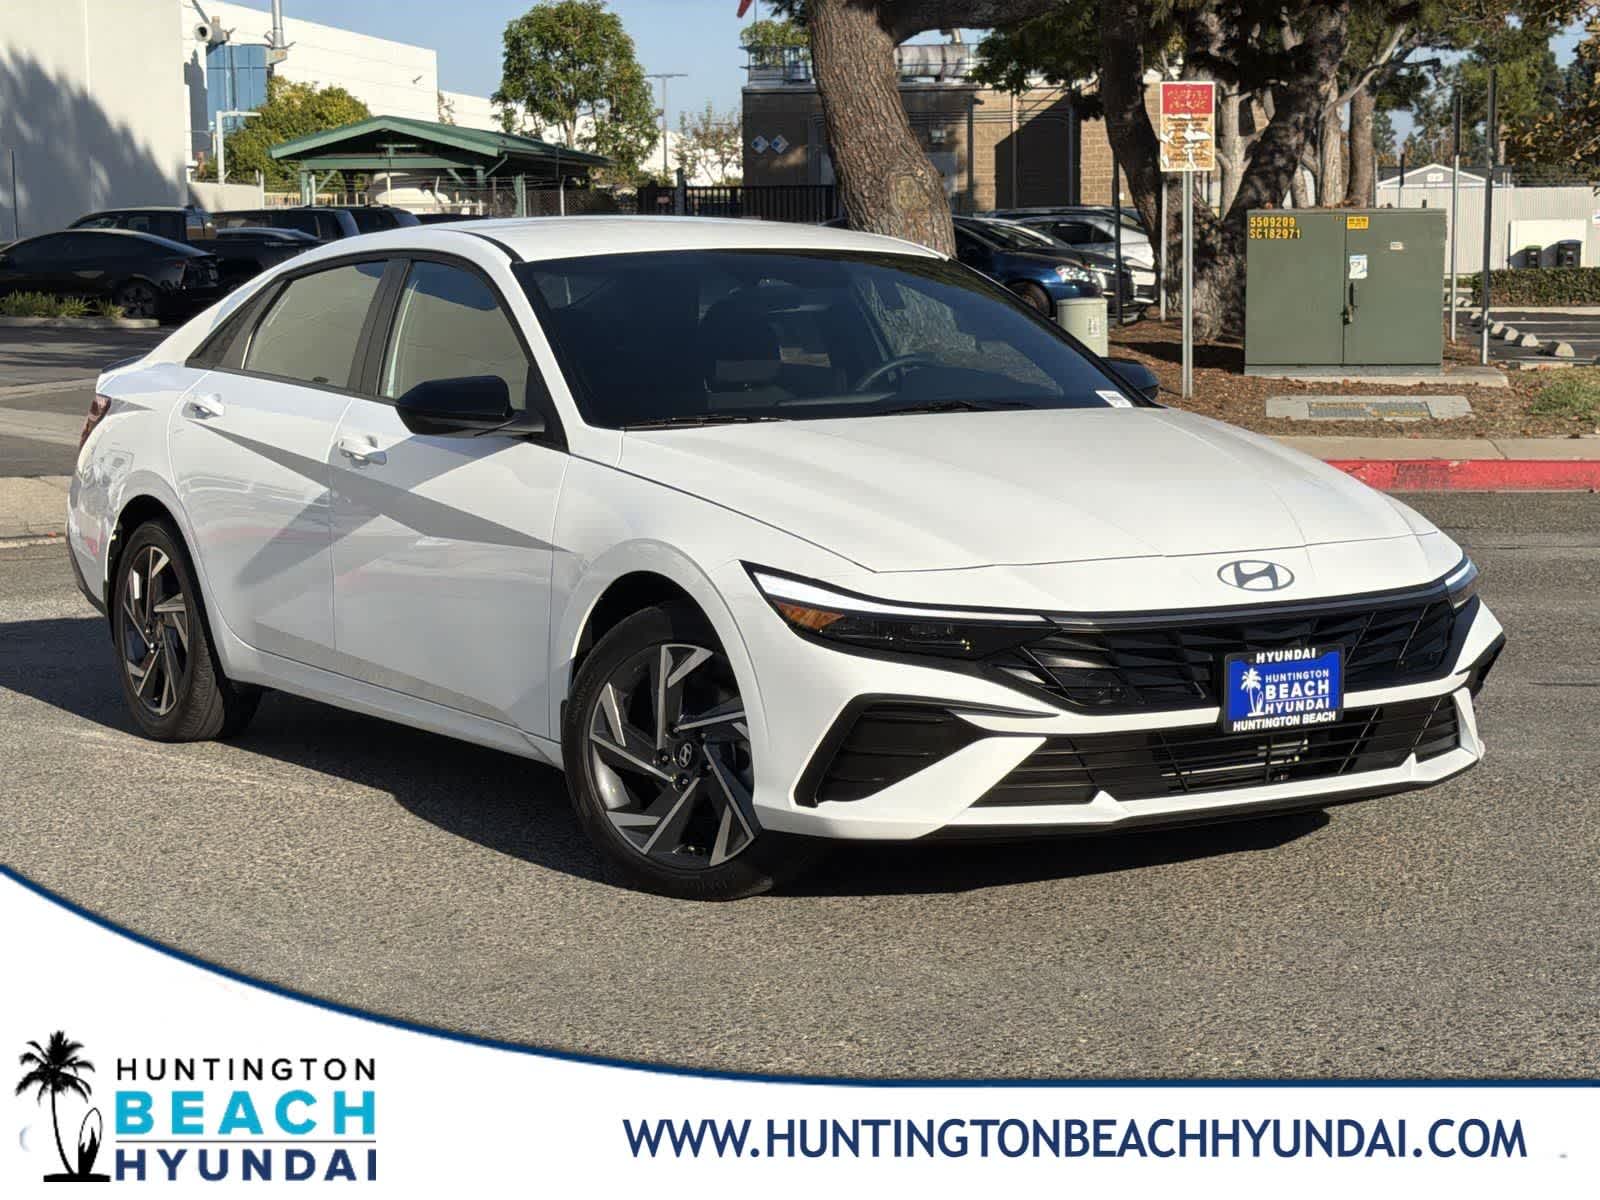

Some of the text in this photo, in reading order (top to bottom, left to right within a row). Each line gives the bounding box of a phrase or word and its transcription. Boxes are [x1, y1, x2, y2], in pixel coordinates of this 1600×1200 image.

[1250, 216, 1295, 228] 5509209
[1256, 648, 1316, 664] HYUNDAI
[1265, 669, 1329, 683] HUNTINGTON
[1265, 679, 1329, 700] BEACH
[1265, 698, 1329, 714] HYUNDAI
[1233, 711, 1336, 732] HUNTINGTON BEACH
